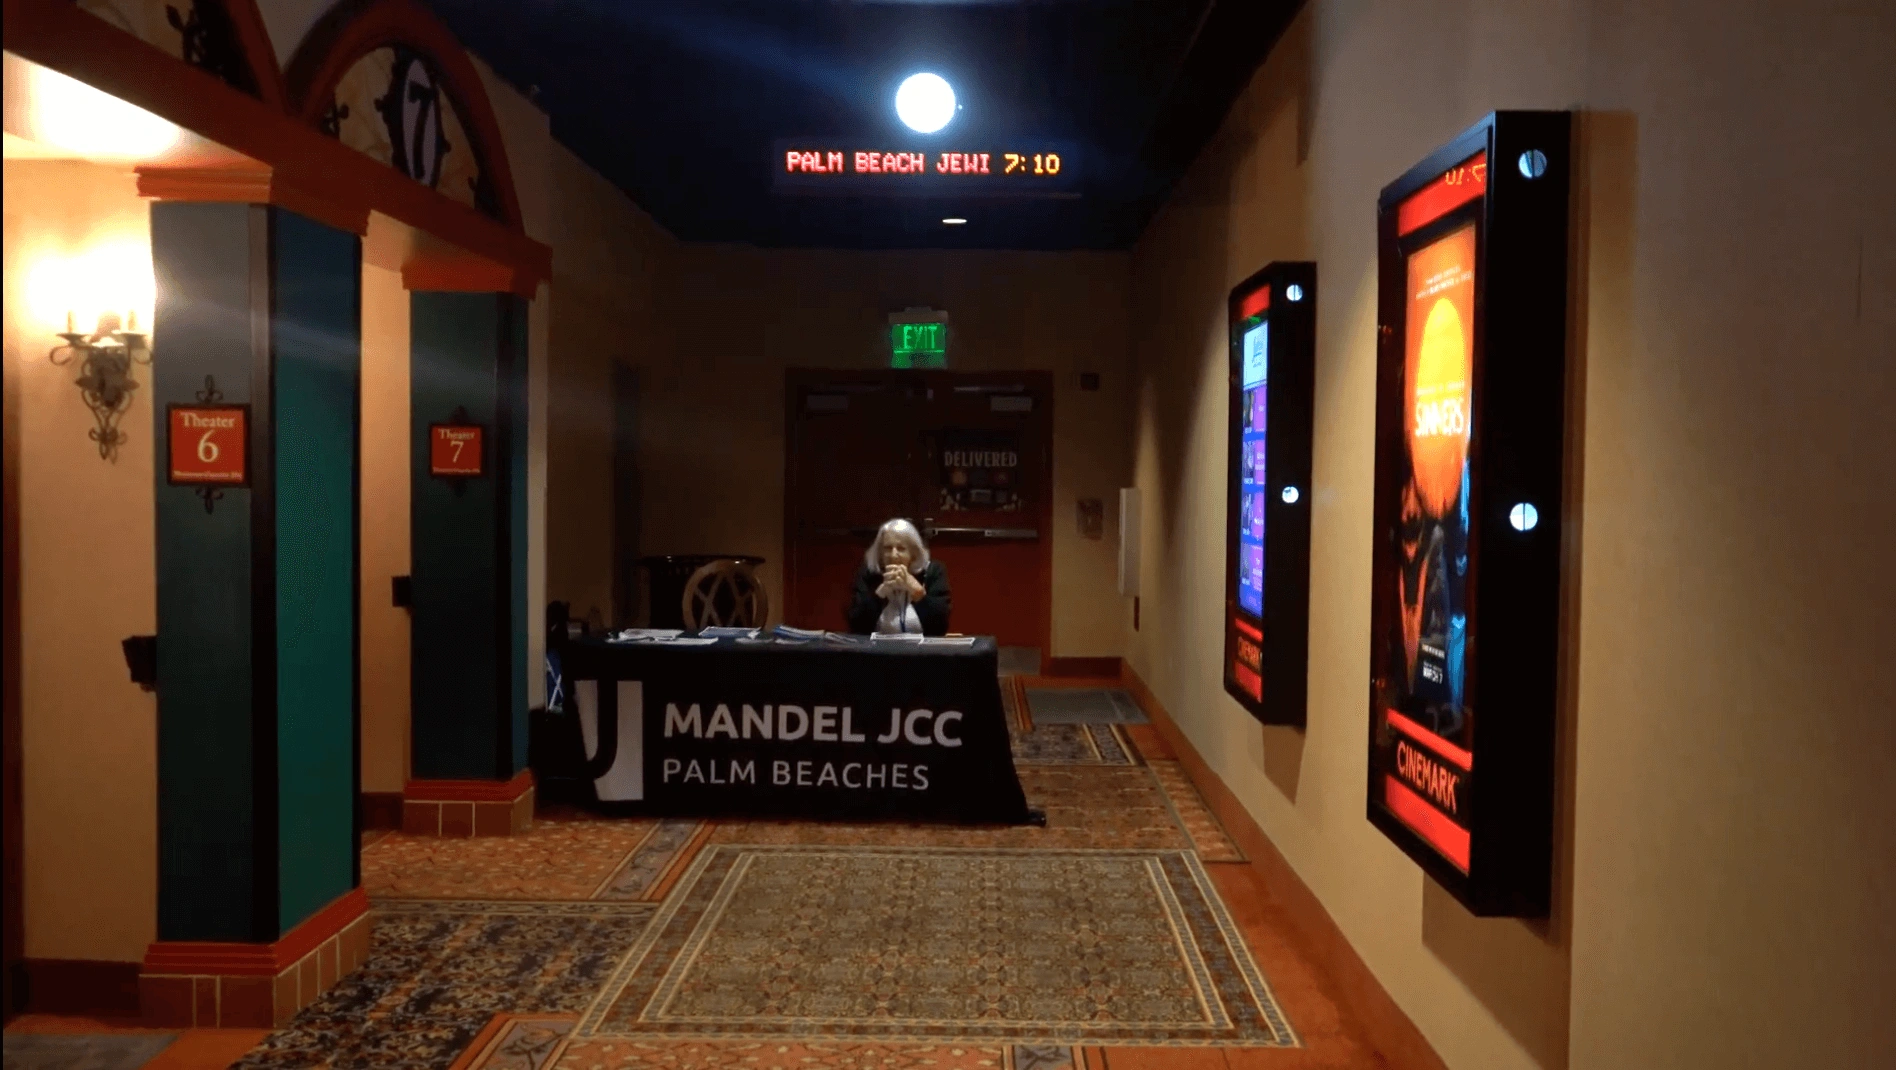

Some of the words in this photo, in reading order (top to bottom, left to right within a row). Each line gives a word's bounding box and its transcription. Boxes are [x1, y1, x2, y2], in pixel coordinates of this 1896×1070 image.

[408, 79, 434, 179] 7
[786, 151, 844, 173] PALM
[855, 152, 924, 173] BEACH
[936, 152, 990, 174] JEWI
[1004, 153, 1061, 174] 7:10
[903, 325, 938, 350] EXIT
[180, 411, 235, 428] Theater
[197, 429, 219, 463] 6
[450, 440, 464, 463] 7
[943, 451, 1018, 468] DELIVERED
[663, 703, 866, 742] MANDEL
[877, 708, 964, 747] JCC
[663, 758, 756, 785] PALM
[772, 760, 930, 790] BEACHES
[1397, 741, 1457, 814] CINEMARK
